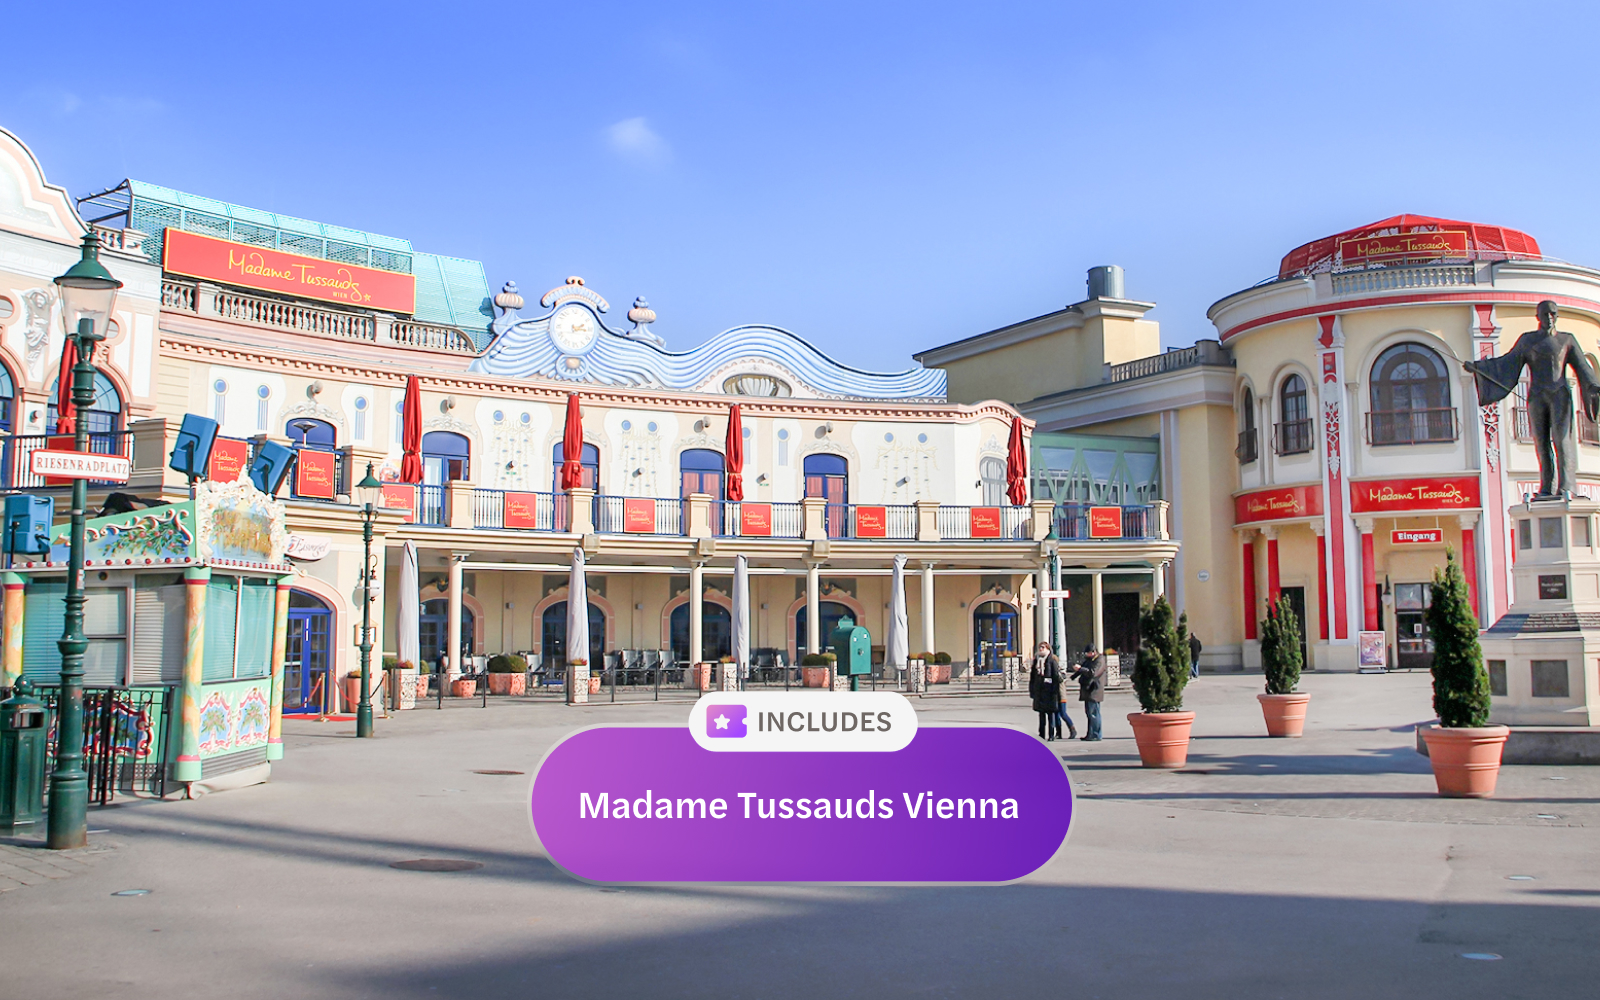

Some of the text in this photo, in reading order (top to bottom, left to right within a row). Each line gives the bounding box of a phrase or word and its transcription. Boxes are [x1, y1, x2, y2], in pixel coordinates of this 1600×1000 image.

[1357, 240, 1403, 256] Madame
[1400, 235, 1452, 255] Tussauds
[229, 249, 362, 302] Madame Tussauds
[36, 456, 128, 475] RIESENRADPLATZ
[1267, 493, 1300, 513] Tussauds
[1369, 483, 1464, 504] Madame Tussauds
[1397, 531, 1437, 542] Eingang
